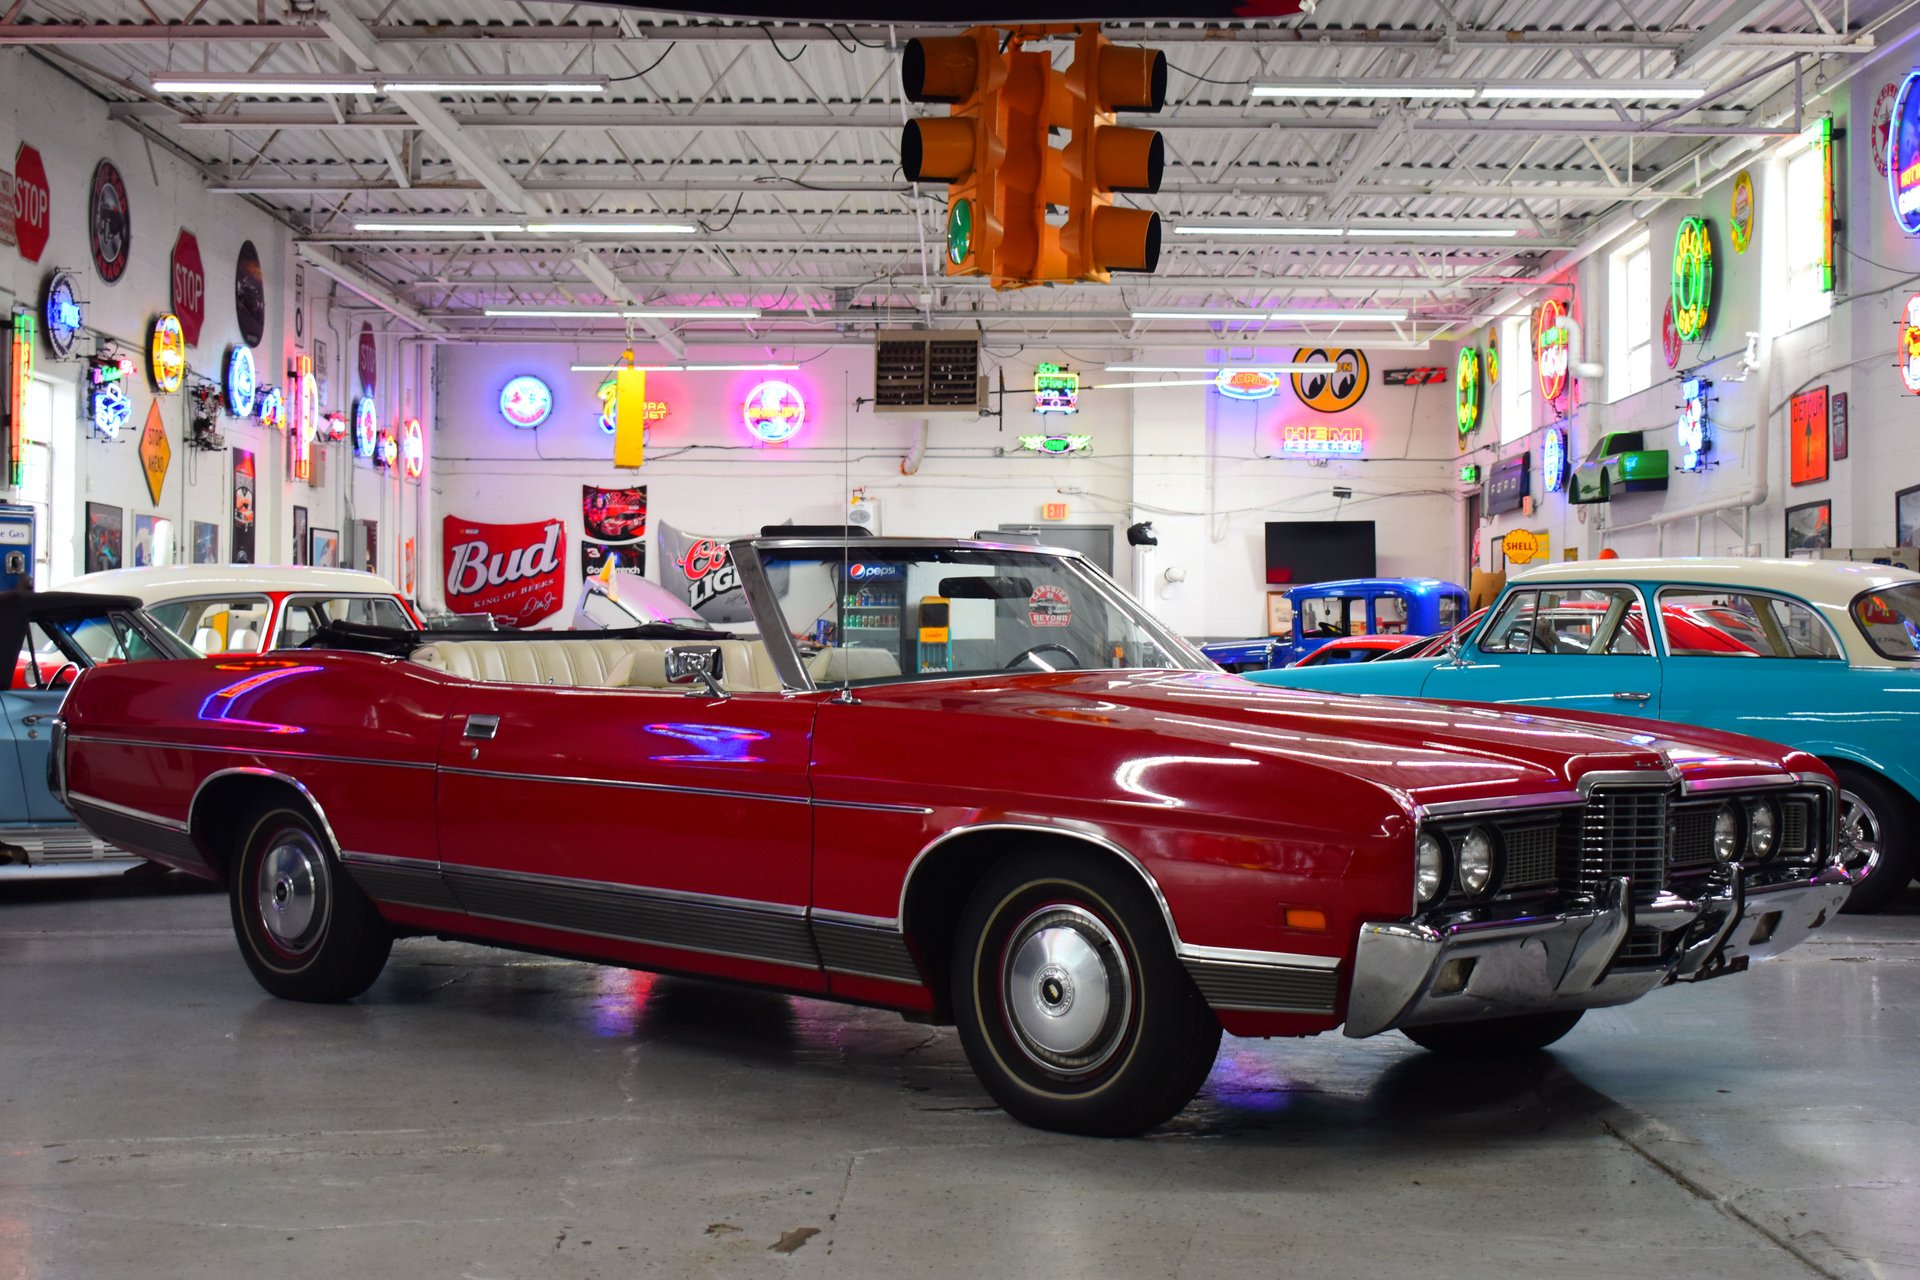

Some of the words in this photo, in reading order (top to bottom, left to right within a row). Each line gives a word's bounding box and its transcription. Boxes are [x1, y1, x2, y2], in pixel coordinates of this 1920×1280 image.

[16, 177, 48, 229] STOP
[175, 262, 207, 312] STOP
[1794, 394, 1824, 422] DETOUR
[1285, 427, 1362, 440] HEMI
[1491, 478, 1516, 493] FORD
[9, 529, 25, 538] Gas
[447, 523, 560, 595] Bud
[587, 548, 601, 558] 3
[587, 566, 640, 575] Goorench
[866, 566, 895, 577] pepsi
[474, 597, 500, 608] KING
[503, 591, 517, 600] OF
[521, 579, 554, 595] BEERS
[689, 566, 742, 608] LIG
